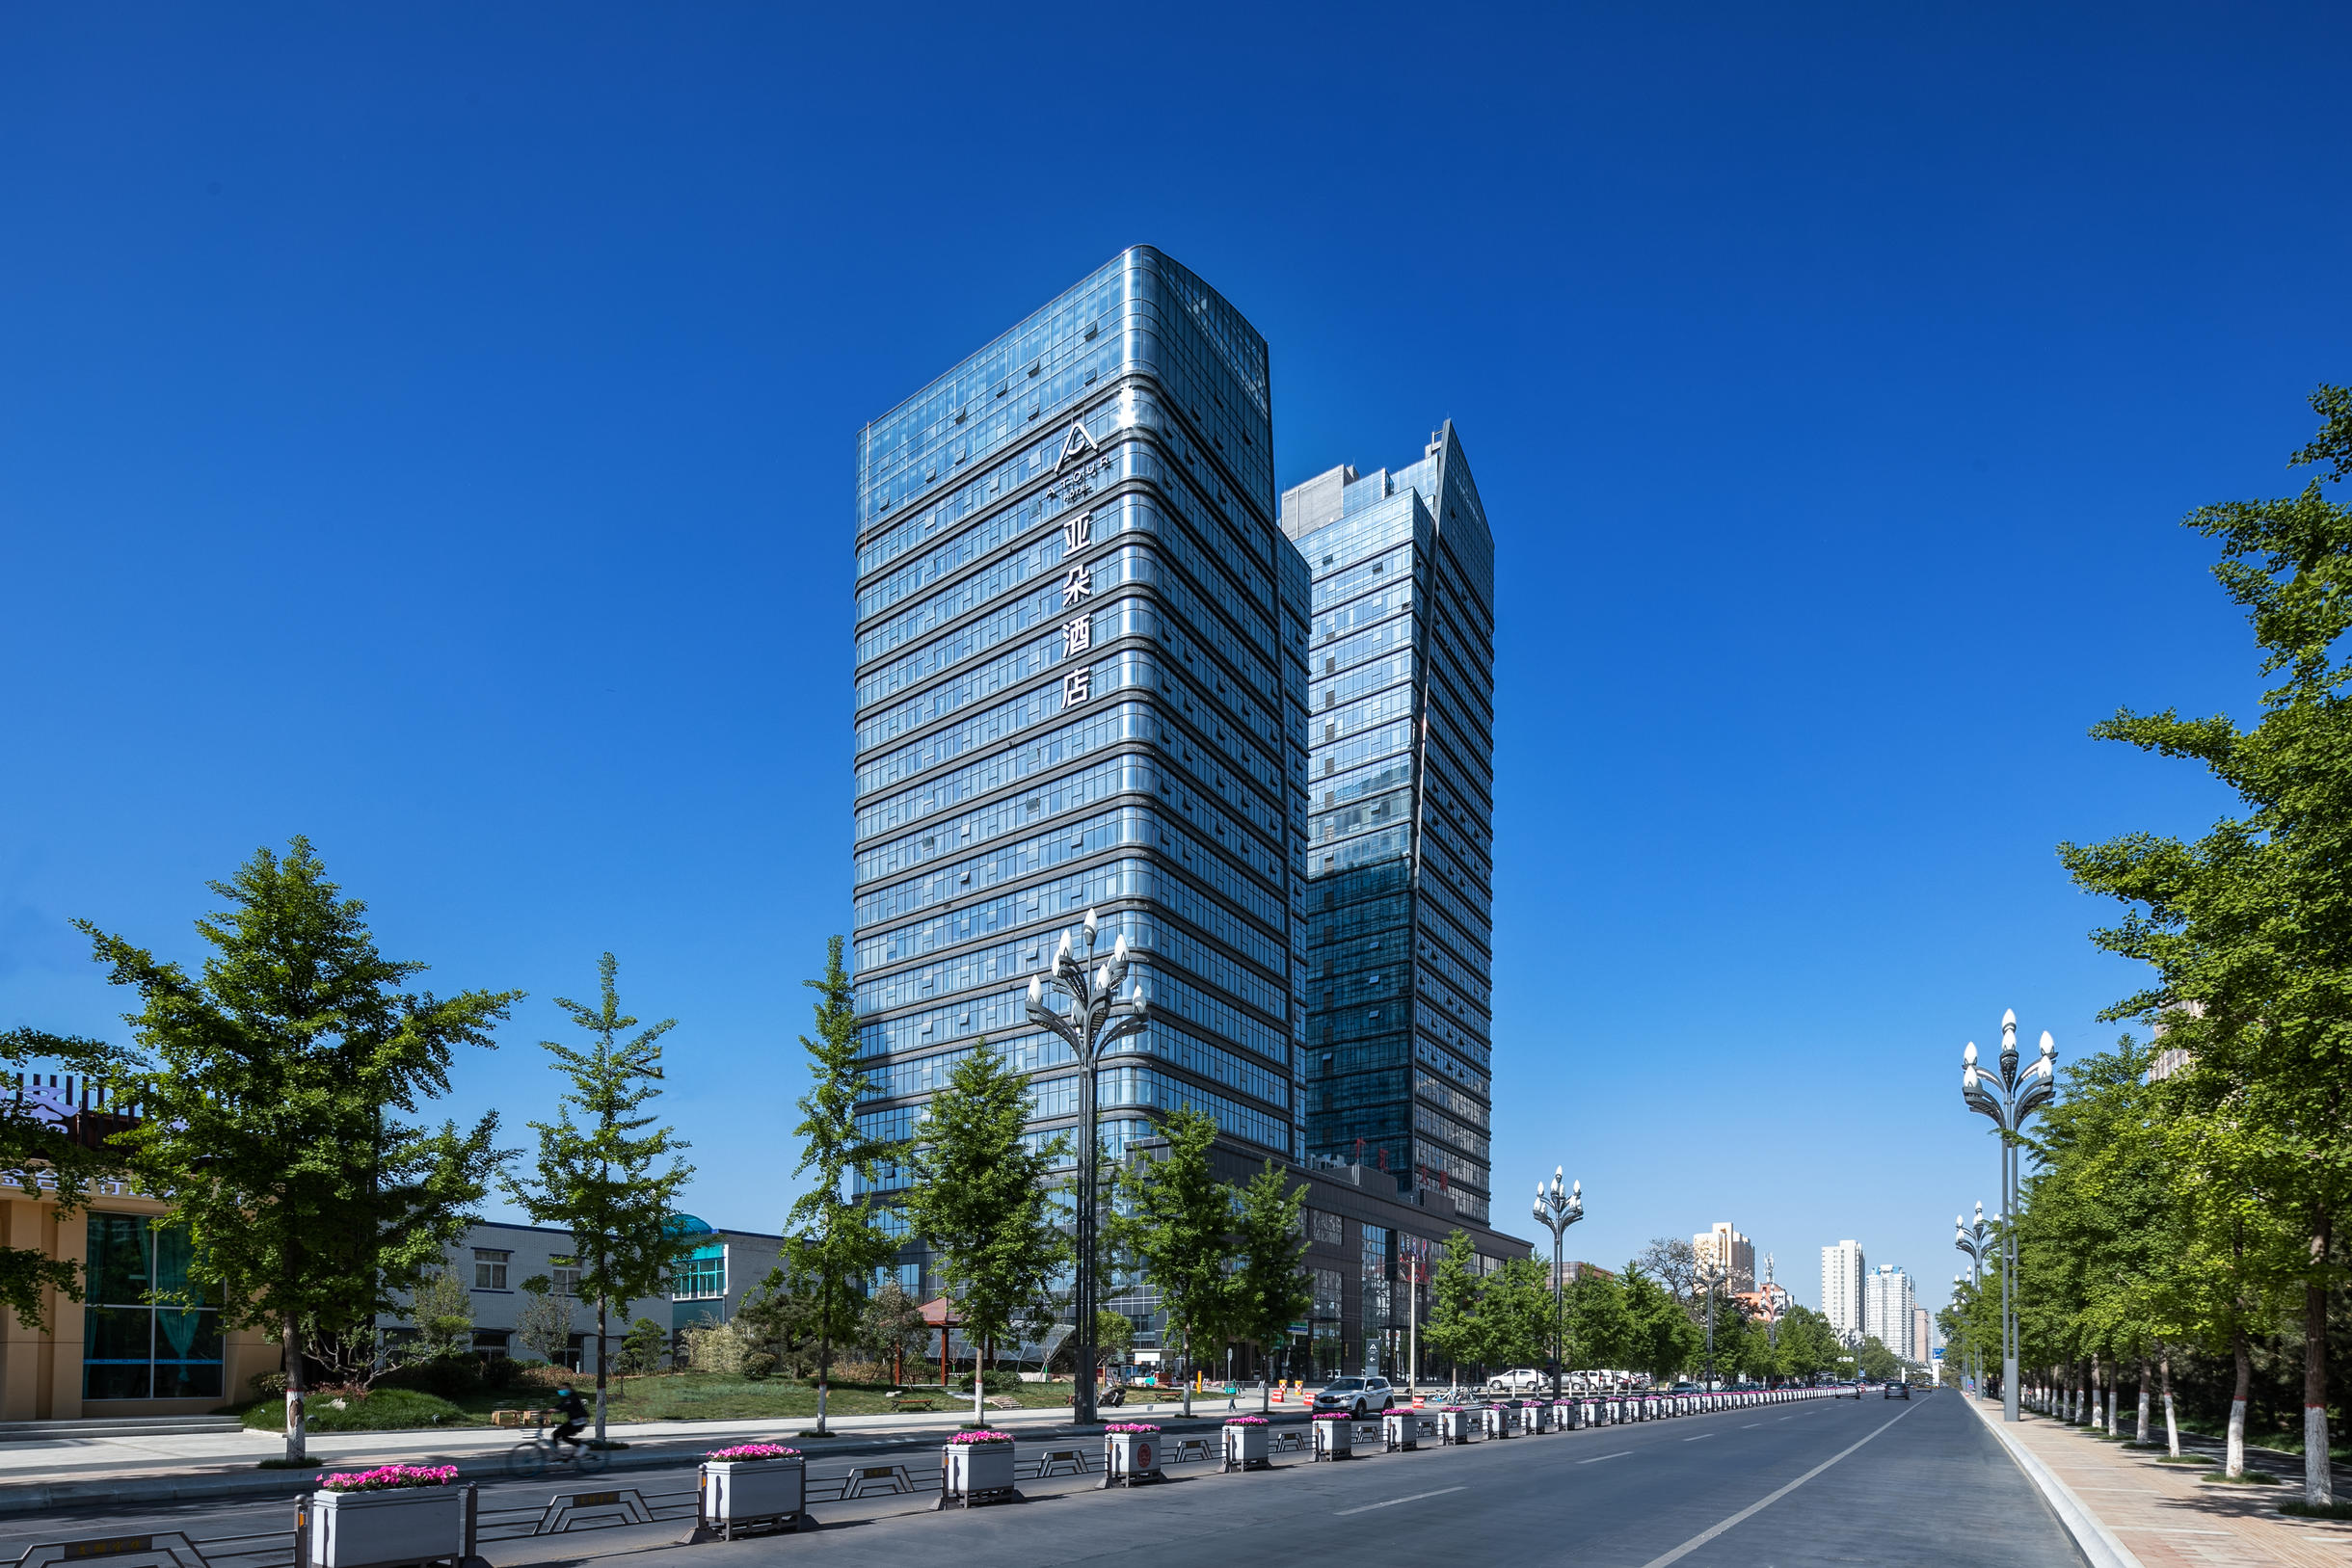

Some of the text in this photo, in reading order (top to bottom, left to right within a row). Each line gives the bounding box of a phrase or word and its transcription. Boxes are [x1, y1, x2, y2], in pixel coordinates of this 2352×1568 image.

[1045, 455, 1109, 498] ATOUR
[1061, 511, 1091, 709] 亚朵酒店
